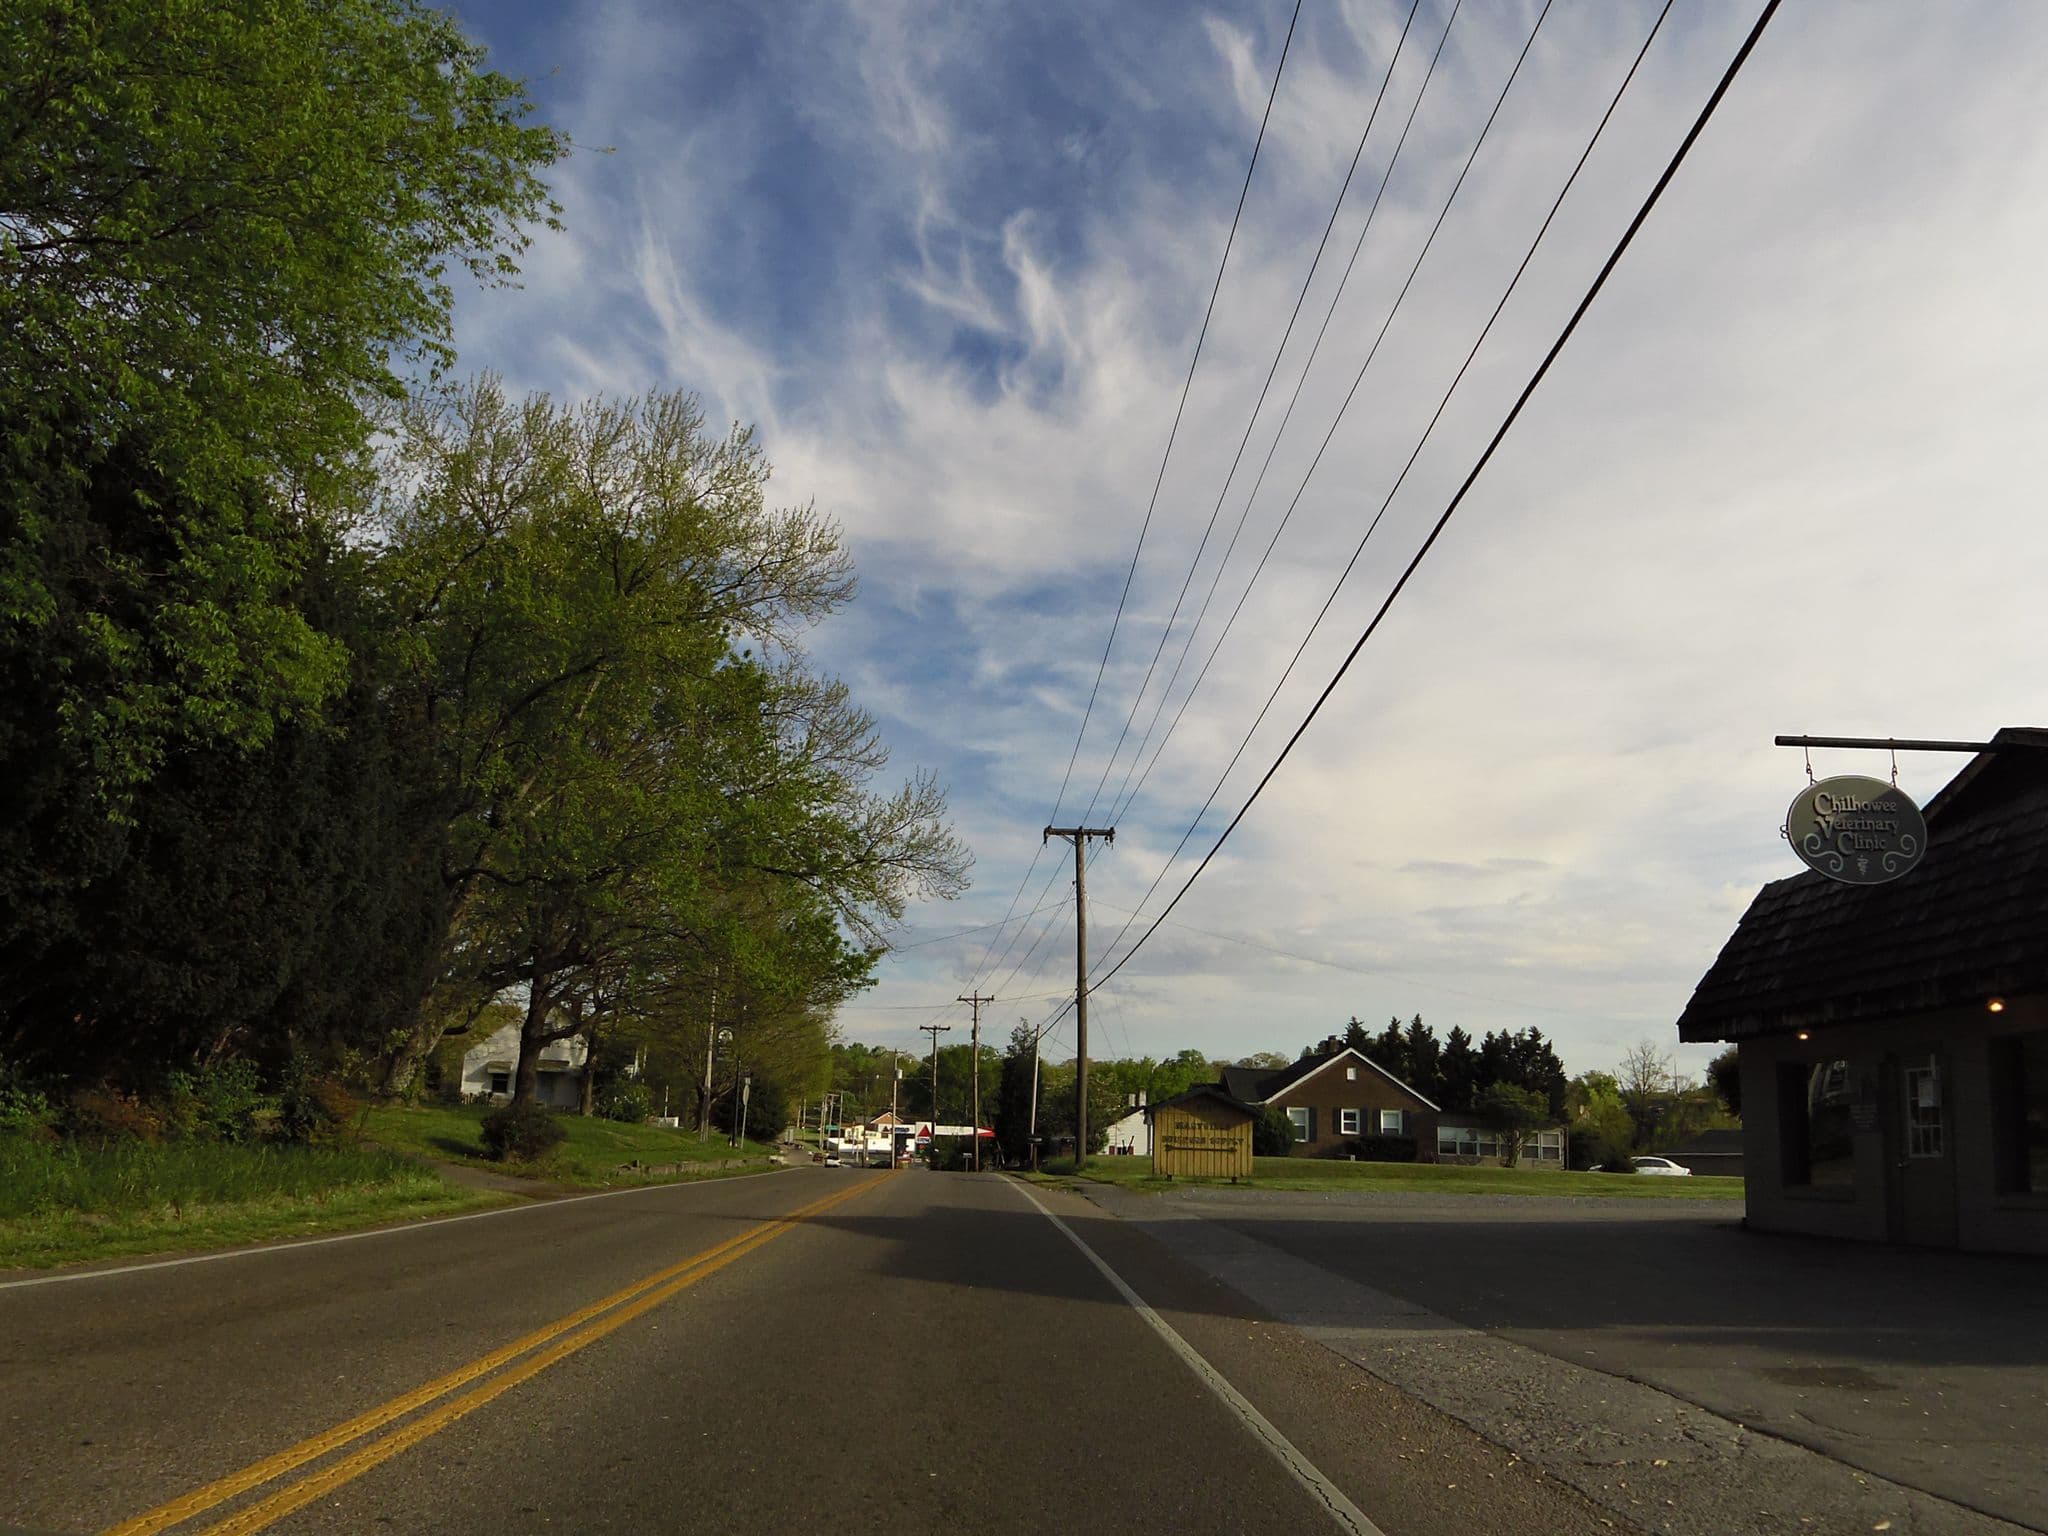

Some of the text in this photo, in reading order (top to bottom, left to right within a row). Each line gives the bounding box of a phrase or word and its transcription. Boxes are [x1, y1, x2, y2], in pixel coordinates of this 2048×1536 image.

[1814, 792, 1897, 815] Chilhowee
[1814, 816, 1898, 838] Veterinary
[1837, 831, 1887, 855] Clinic
